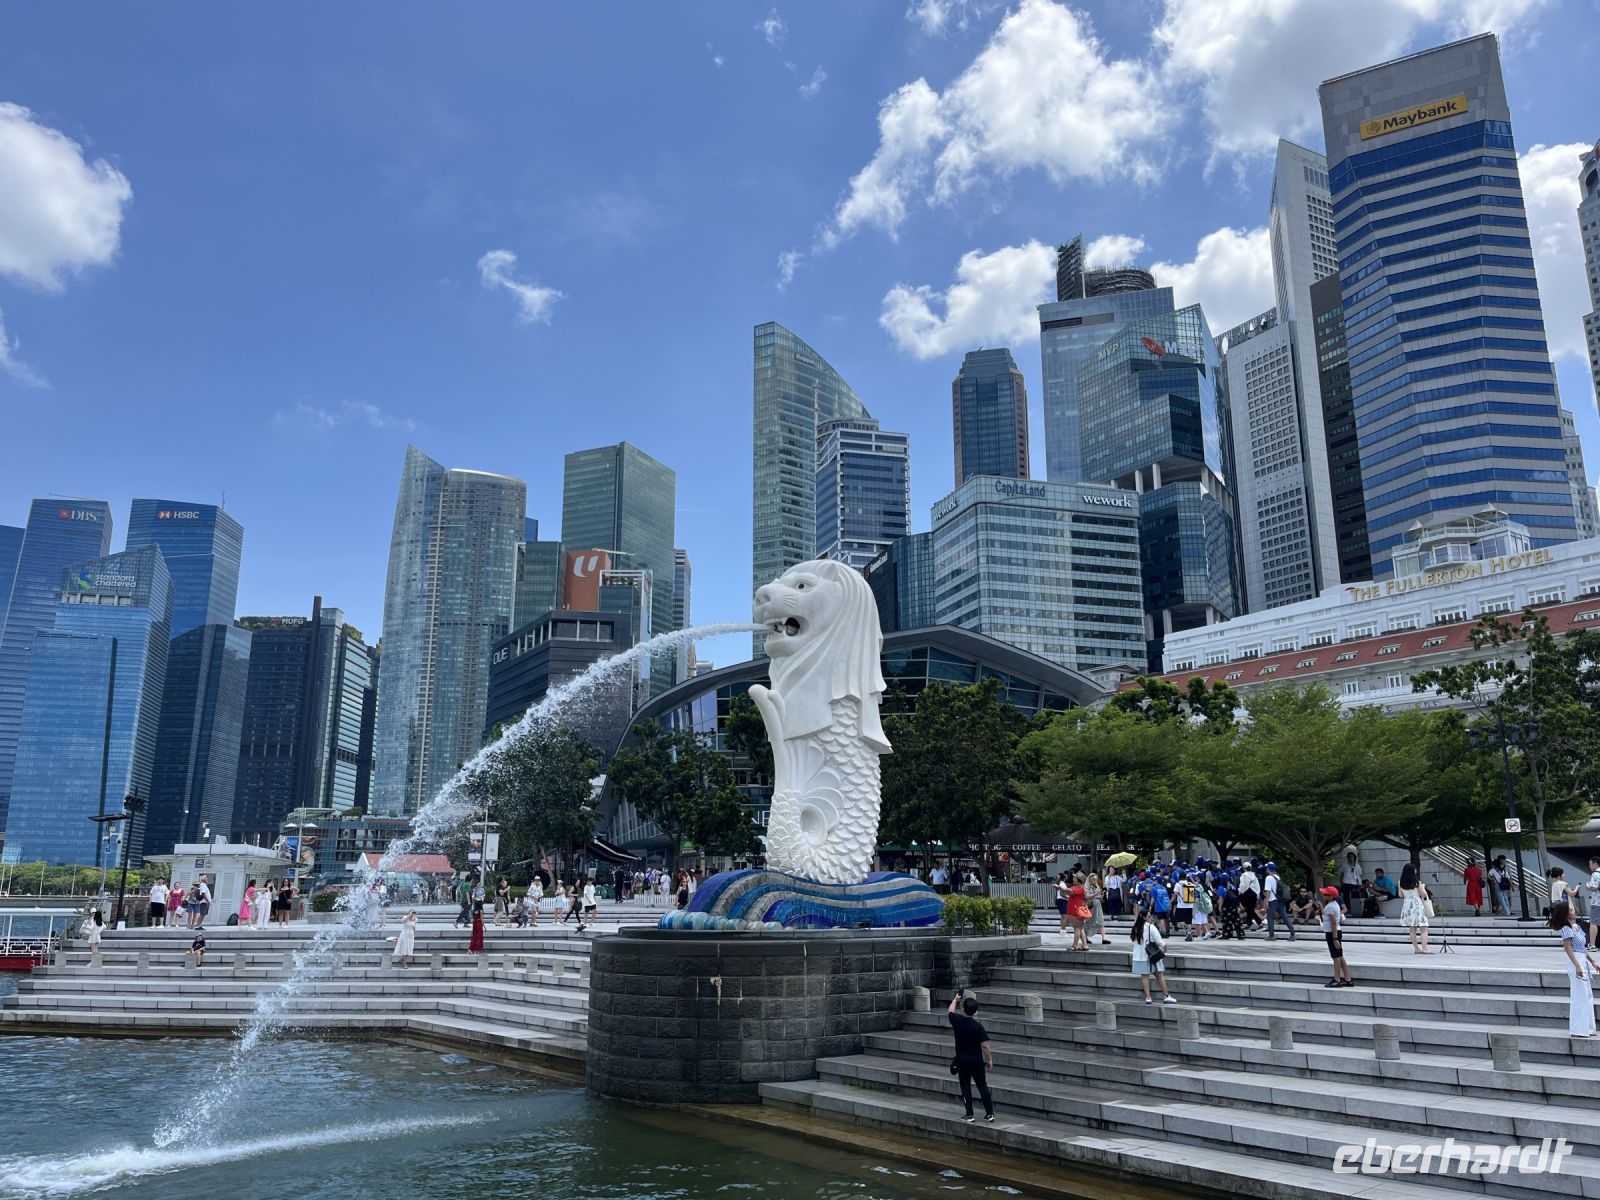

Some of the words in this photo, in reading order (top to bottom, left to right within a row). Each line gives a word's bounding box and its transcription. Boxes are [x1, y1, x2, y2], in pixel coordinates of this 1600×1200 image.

[1383, 101, 1457, 130] Maybank
[1098, 343, 1120, 360] MYP
[995, 480, 1046, 498] CapitaLand
[1082, 494, 1132, 508] wework
[71, 510, 97, 521] DBS
[173, 511, 200, 519] HSBC
[95, 573, 135, 581] standard
[1350, 585, 1380, 601] THE
[1386, 563, 1483, 595] FULLERTON
[1490, 549, 1554, 574] HOTEL
[95, 580, 136, 588] chartered
[493, 647, 508, 665] OUE
